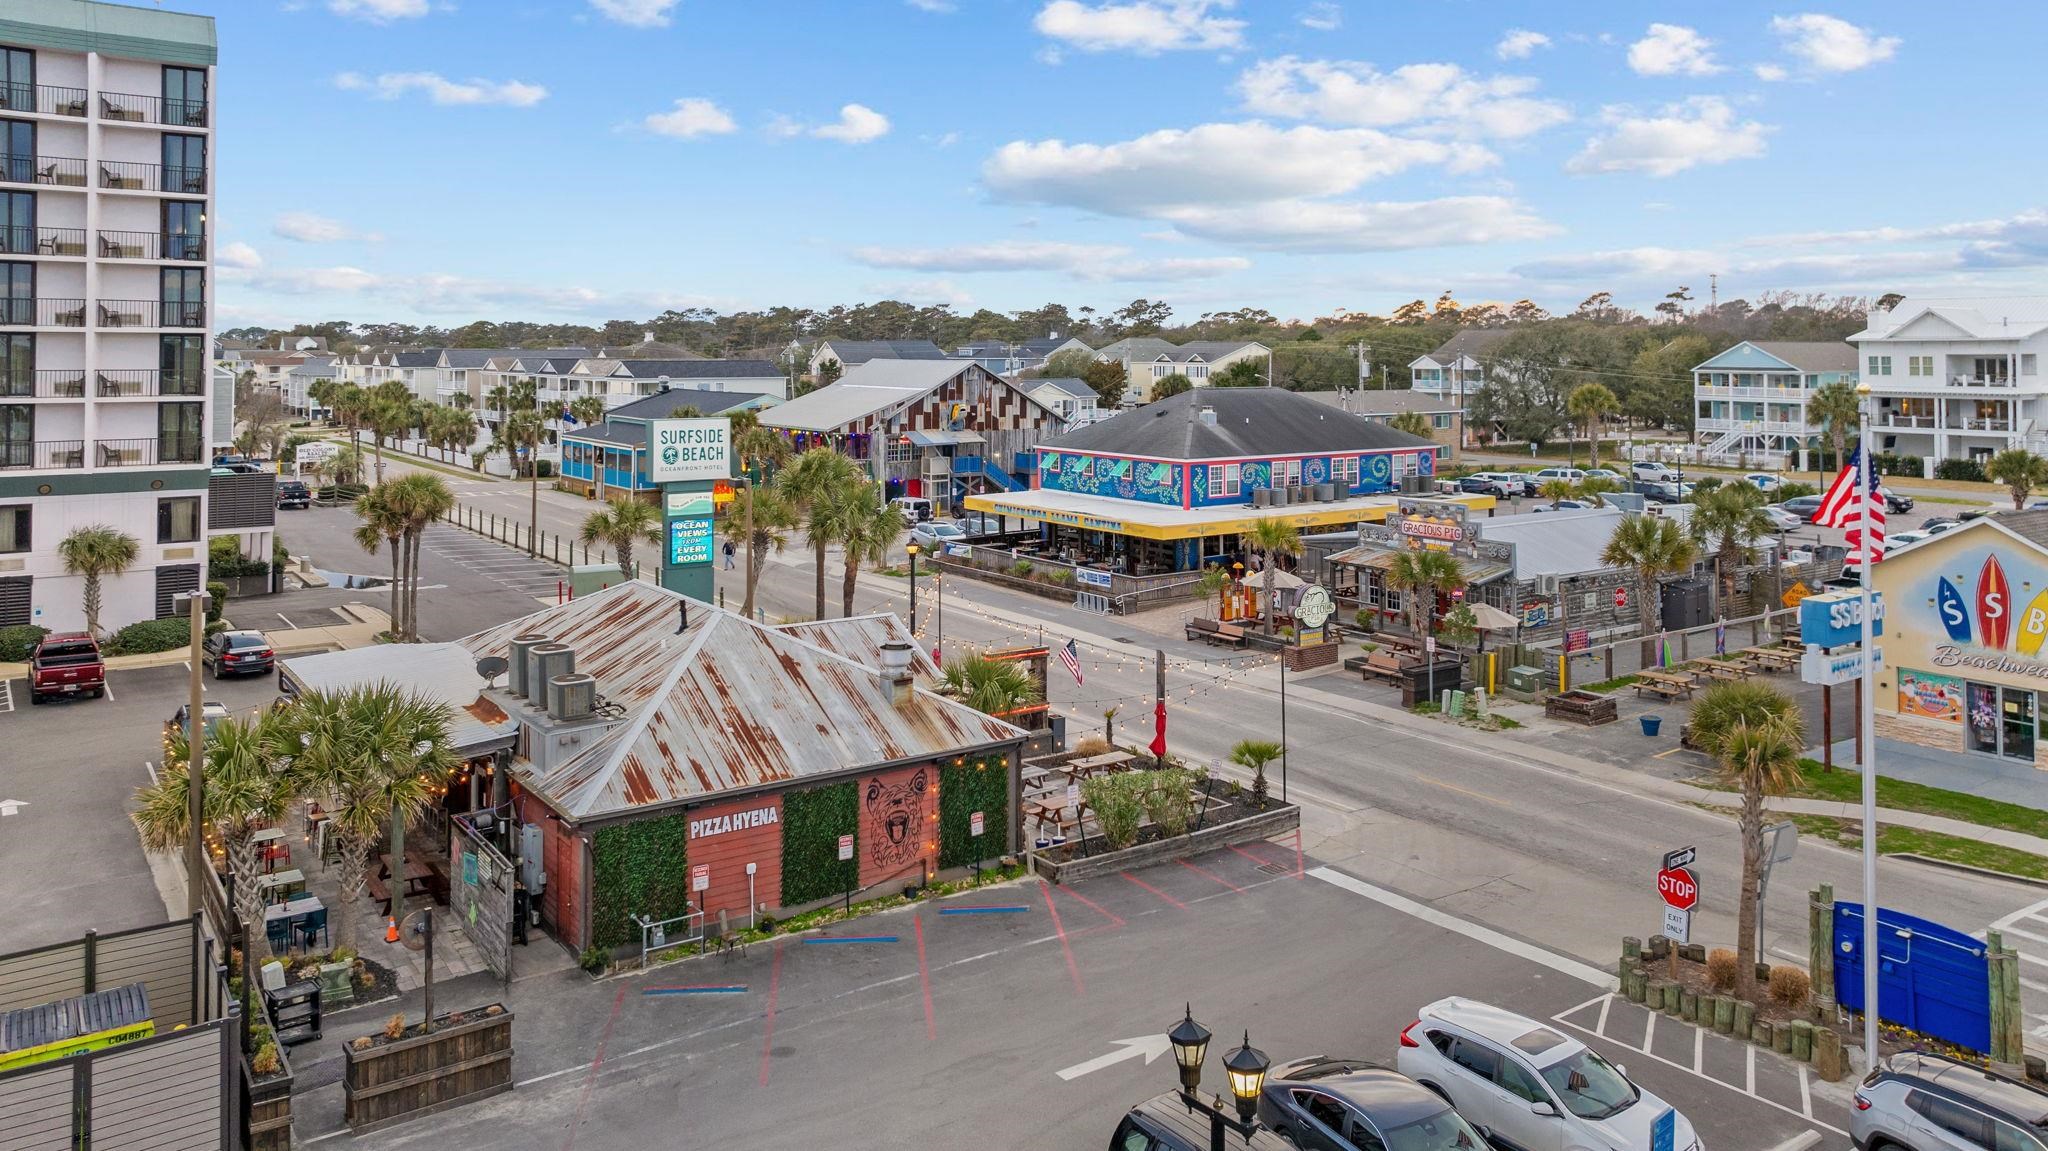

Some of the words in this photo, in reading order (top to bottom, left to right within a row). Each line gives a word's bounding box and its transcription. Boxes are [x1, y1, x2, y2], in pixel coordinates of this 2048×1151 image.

[660, 429, 724, 445] SURFSIDE
[682, 446, 724, 461] BEACH
[676, 521, 709, 530] OCEAN
[1403, 522, 1442, 537] GRACIOUS
[1444, 527, 1461, 539] PIG
[677, 529, 708, 538] VIEWS
[677, 545, 707, 554] EVERY
[677, 553, 708, 562] ROOM
[1297, 603, 1334, 618] GRACIOUS
[1943, 600, 1963, 626] S
[1985, 592, 2003, 618] S
[2026, 607, 2046, 635] B
[690, 815, 732, 839] PIZZA
[733, 806, 778, 831] HYENA
[1660, 875, 1694, 899] STOP
[1668, 913, 1682, 923] EXIT
[1666, 924, 1683, 935] ONLY
